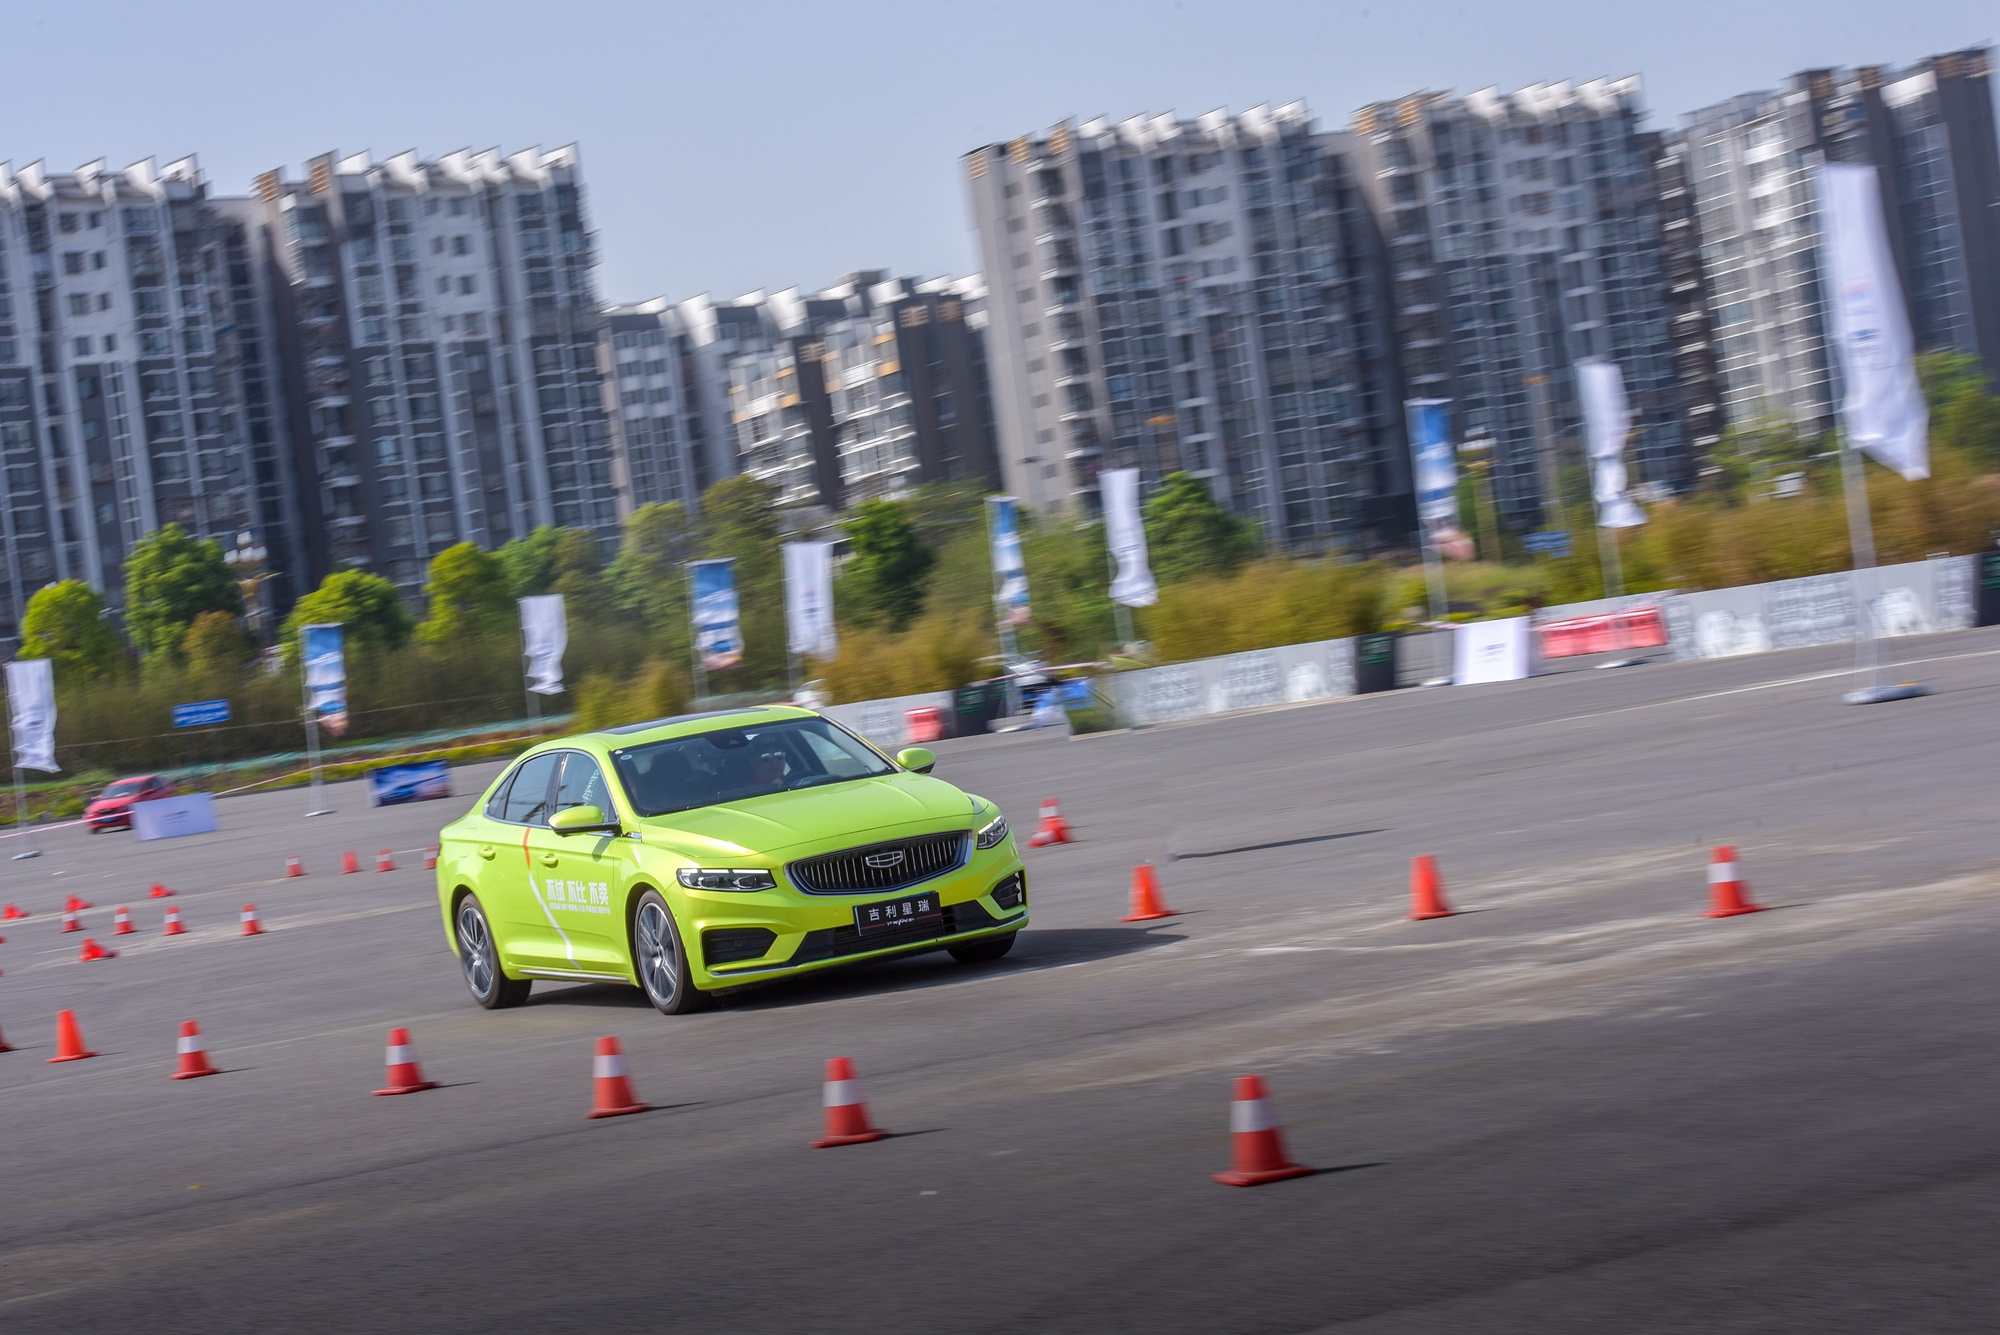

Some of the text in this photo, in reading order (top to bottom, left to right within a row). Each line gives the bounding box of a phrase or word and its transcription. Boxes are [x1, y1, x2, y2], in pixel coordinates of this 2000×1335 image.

[567, 880, 587, 903] 不比
[588, 882, 609, 905] 不卖
[868, 898, 930, 922] 吉利星瑞
